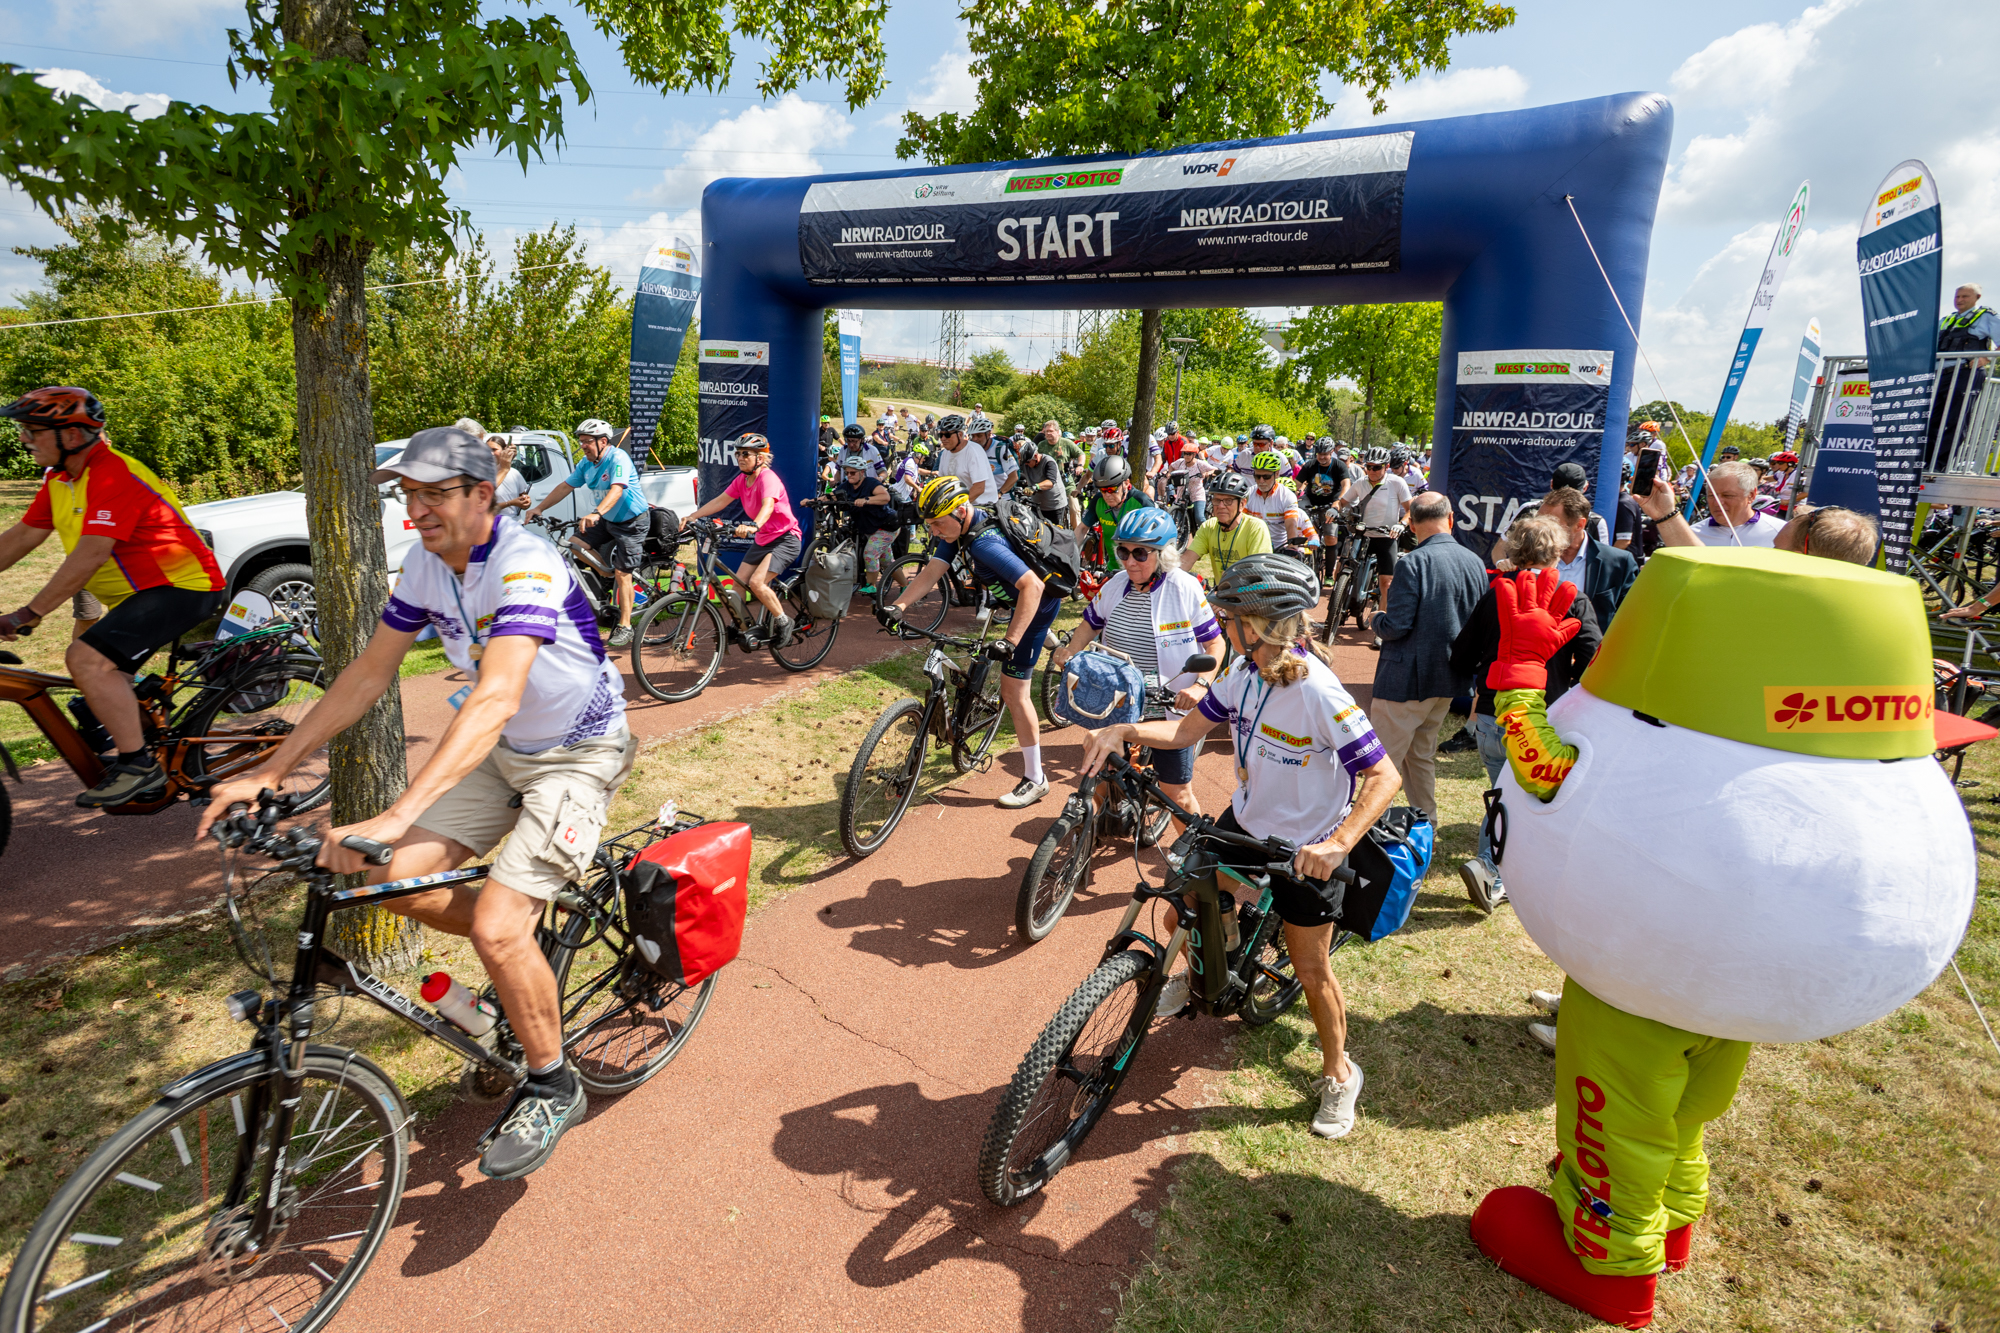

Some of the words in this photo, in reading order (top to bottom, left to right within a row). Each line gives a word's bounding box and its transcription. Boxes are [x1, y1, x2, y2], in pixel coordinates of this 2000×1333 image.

[1183, 163, 1218, 176] WDR
[1009, 177, 1053, 191] WEST
[1066, 171, 1120, 187] LOTTO
[1180, 199, 1329, 227] NRWRADTOUR
[841, 223, 945, 243] NRWRADTOUR
[996, 211, 1120, 261] START
[1197, 229, 1309, 246] www.nrw-radtour.de
[855, 248, 933, 259] www.nrw-radtour.de
[641, 281, 698, 300] NRWRADTOUR
[699, 381, 759, 394] RWRADTOUR
[1843, 384, 1870, 396] WES
[1462, 411, 1595, 429] NRWRADTOUR
[1473, 436, 1576, 447] www.nrw-radtour.de
[698, 437, 738, 466] STAR
[1456, 494, 1526, 535] STA
[1826, 694, 1922, 722] LOTTO
[1262, 724, 1281, 739] WEST
[1286, 735, 1312, 746] LOTTO
[1282, 756, 1302, 767] WDR
[1575, 1075, 1612, 1203] LOTTO
